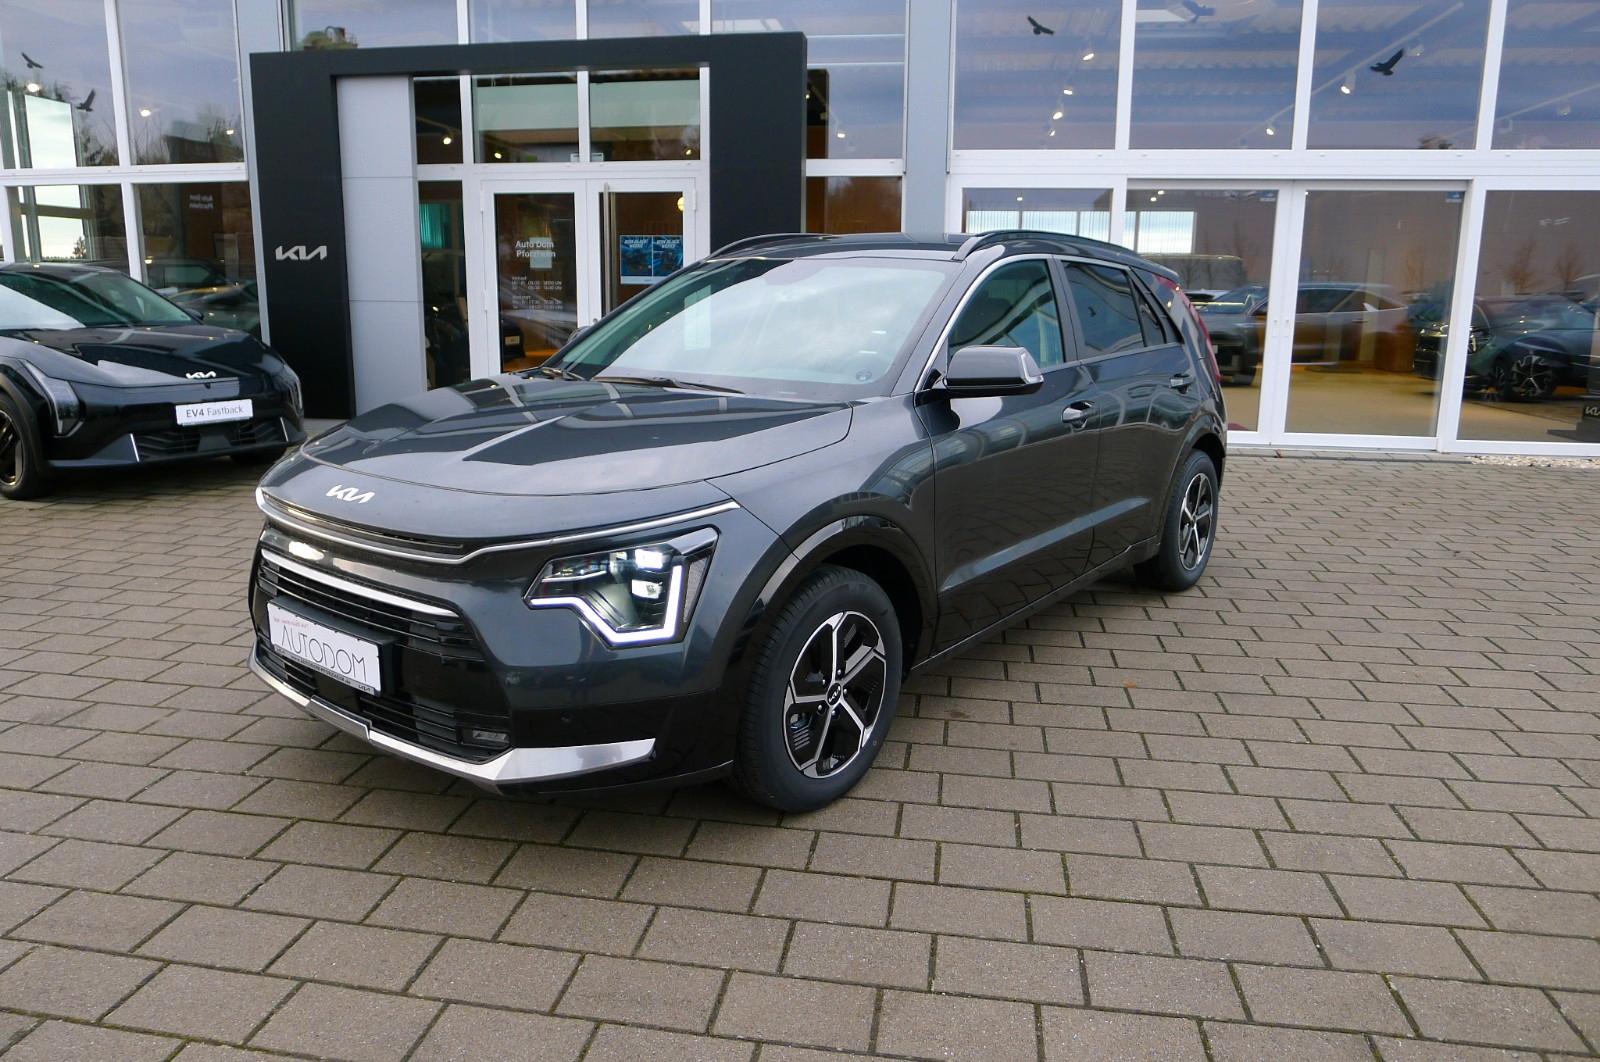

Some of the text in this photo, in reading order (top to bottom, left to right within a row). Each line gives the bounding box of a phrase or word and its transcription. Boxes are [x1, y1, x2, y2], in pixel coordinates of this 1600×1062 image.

[515, 240, 534, 248] Auto
[275, 245, 327, 260] KIA
[185, 371, 217, 380] KIA
[185, 404, 244, 418] EV4 Fastback
[325, 484, 376, 504] KIA
[281, 624, 367, 683] AUTODOM
[828, 685, 841, 703] KIA
